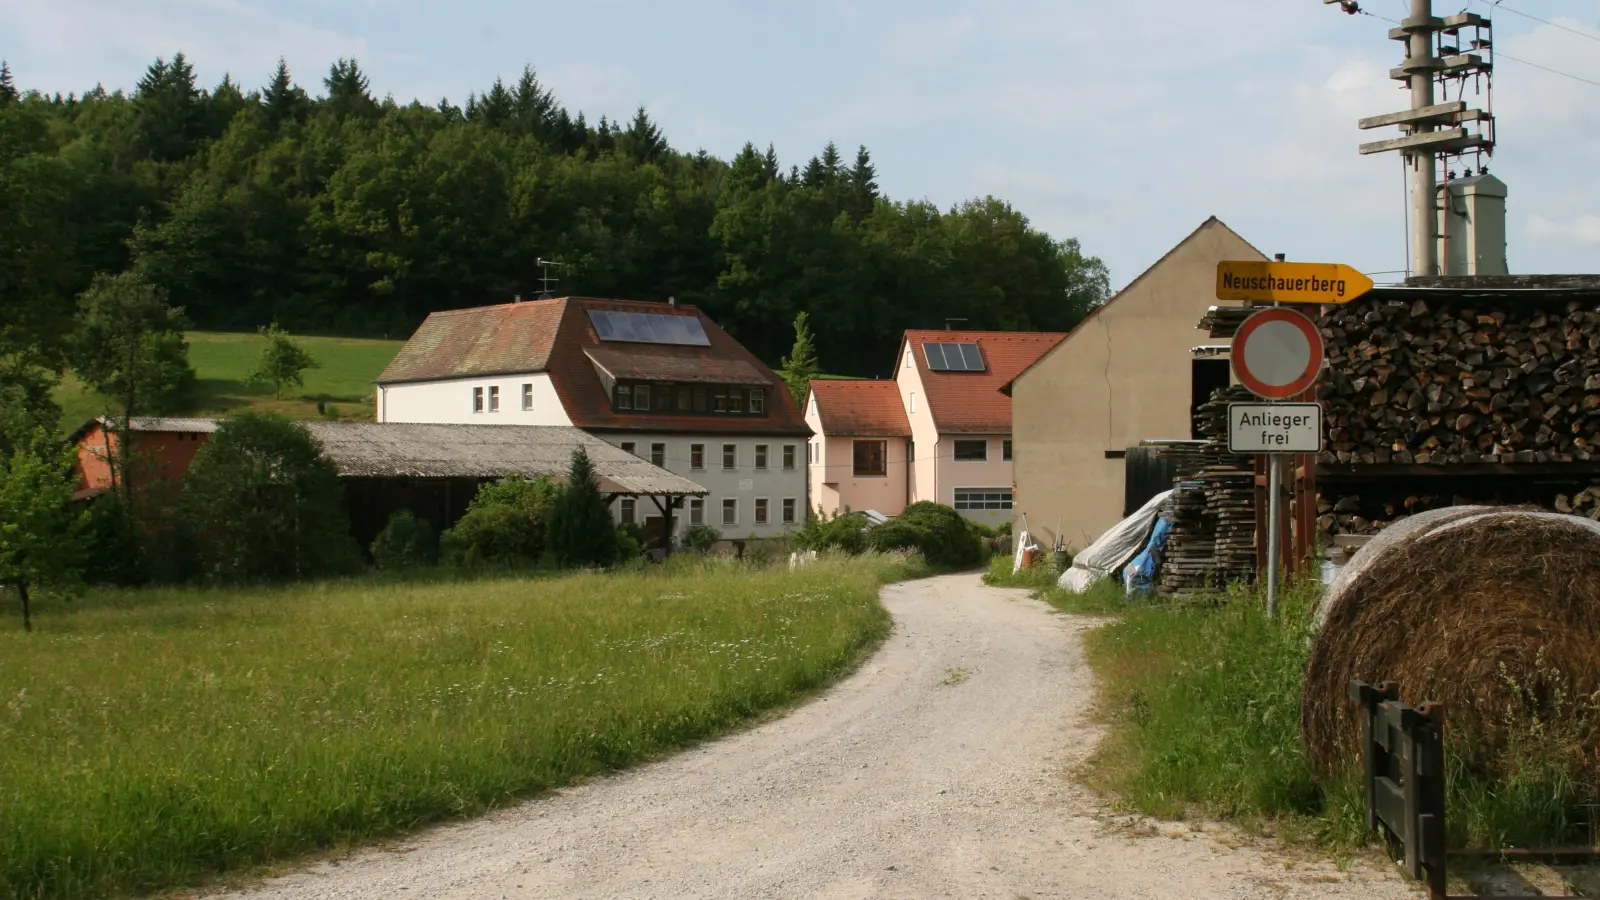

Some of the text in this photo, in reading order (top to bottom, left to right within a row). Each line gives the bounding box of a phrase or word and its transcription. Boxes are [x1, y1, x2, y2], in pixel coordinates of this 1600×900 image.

[1223, 272, 1346, 297] Neuschauerberg
[1239, 412, 1310, 430] Anlieger
[1261, 431, 1289, 445] frei
